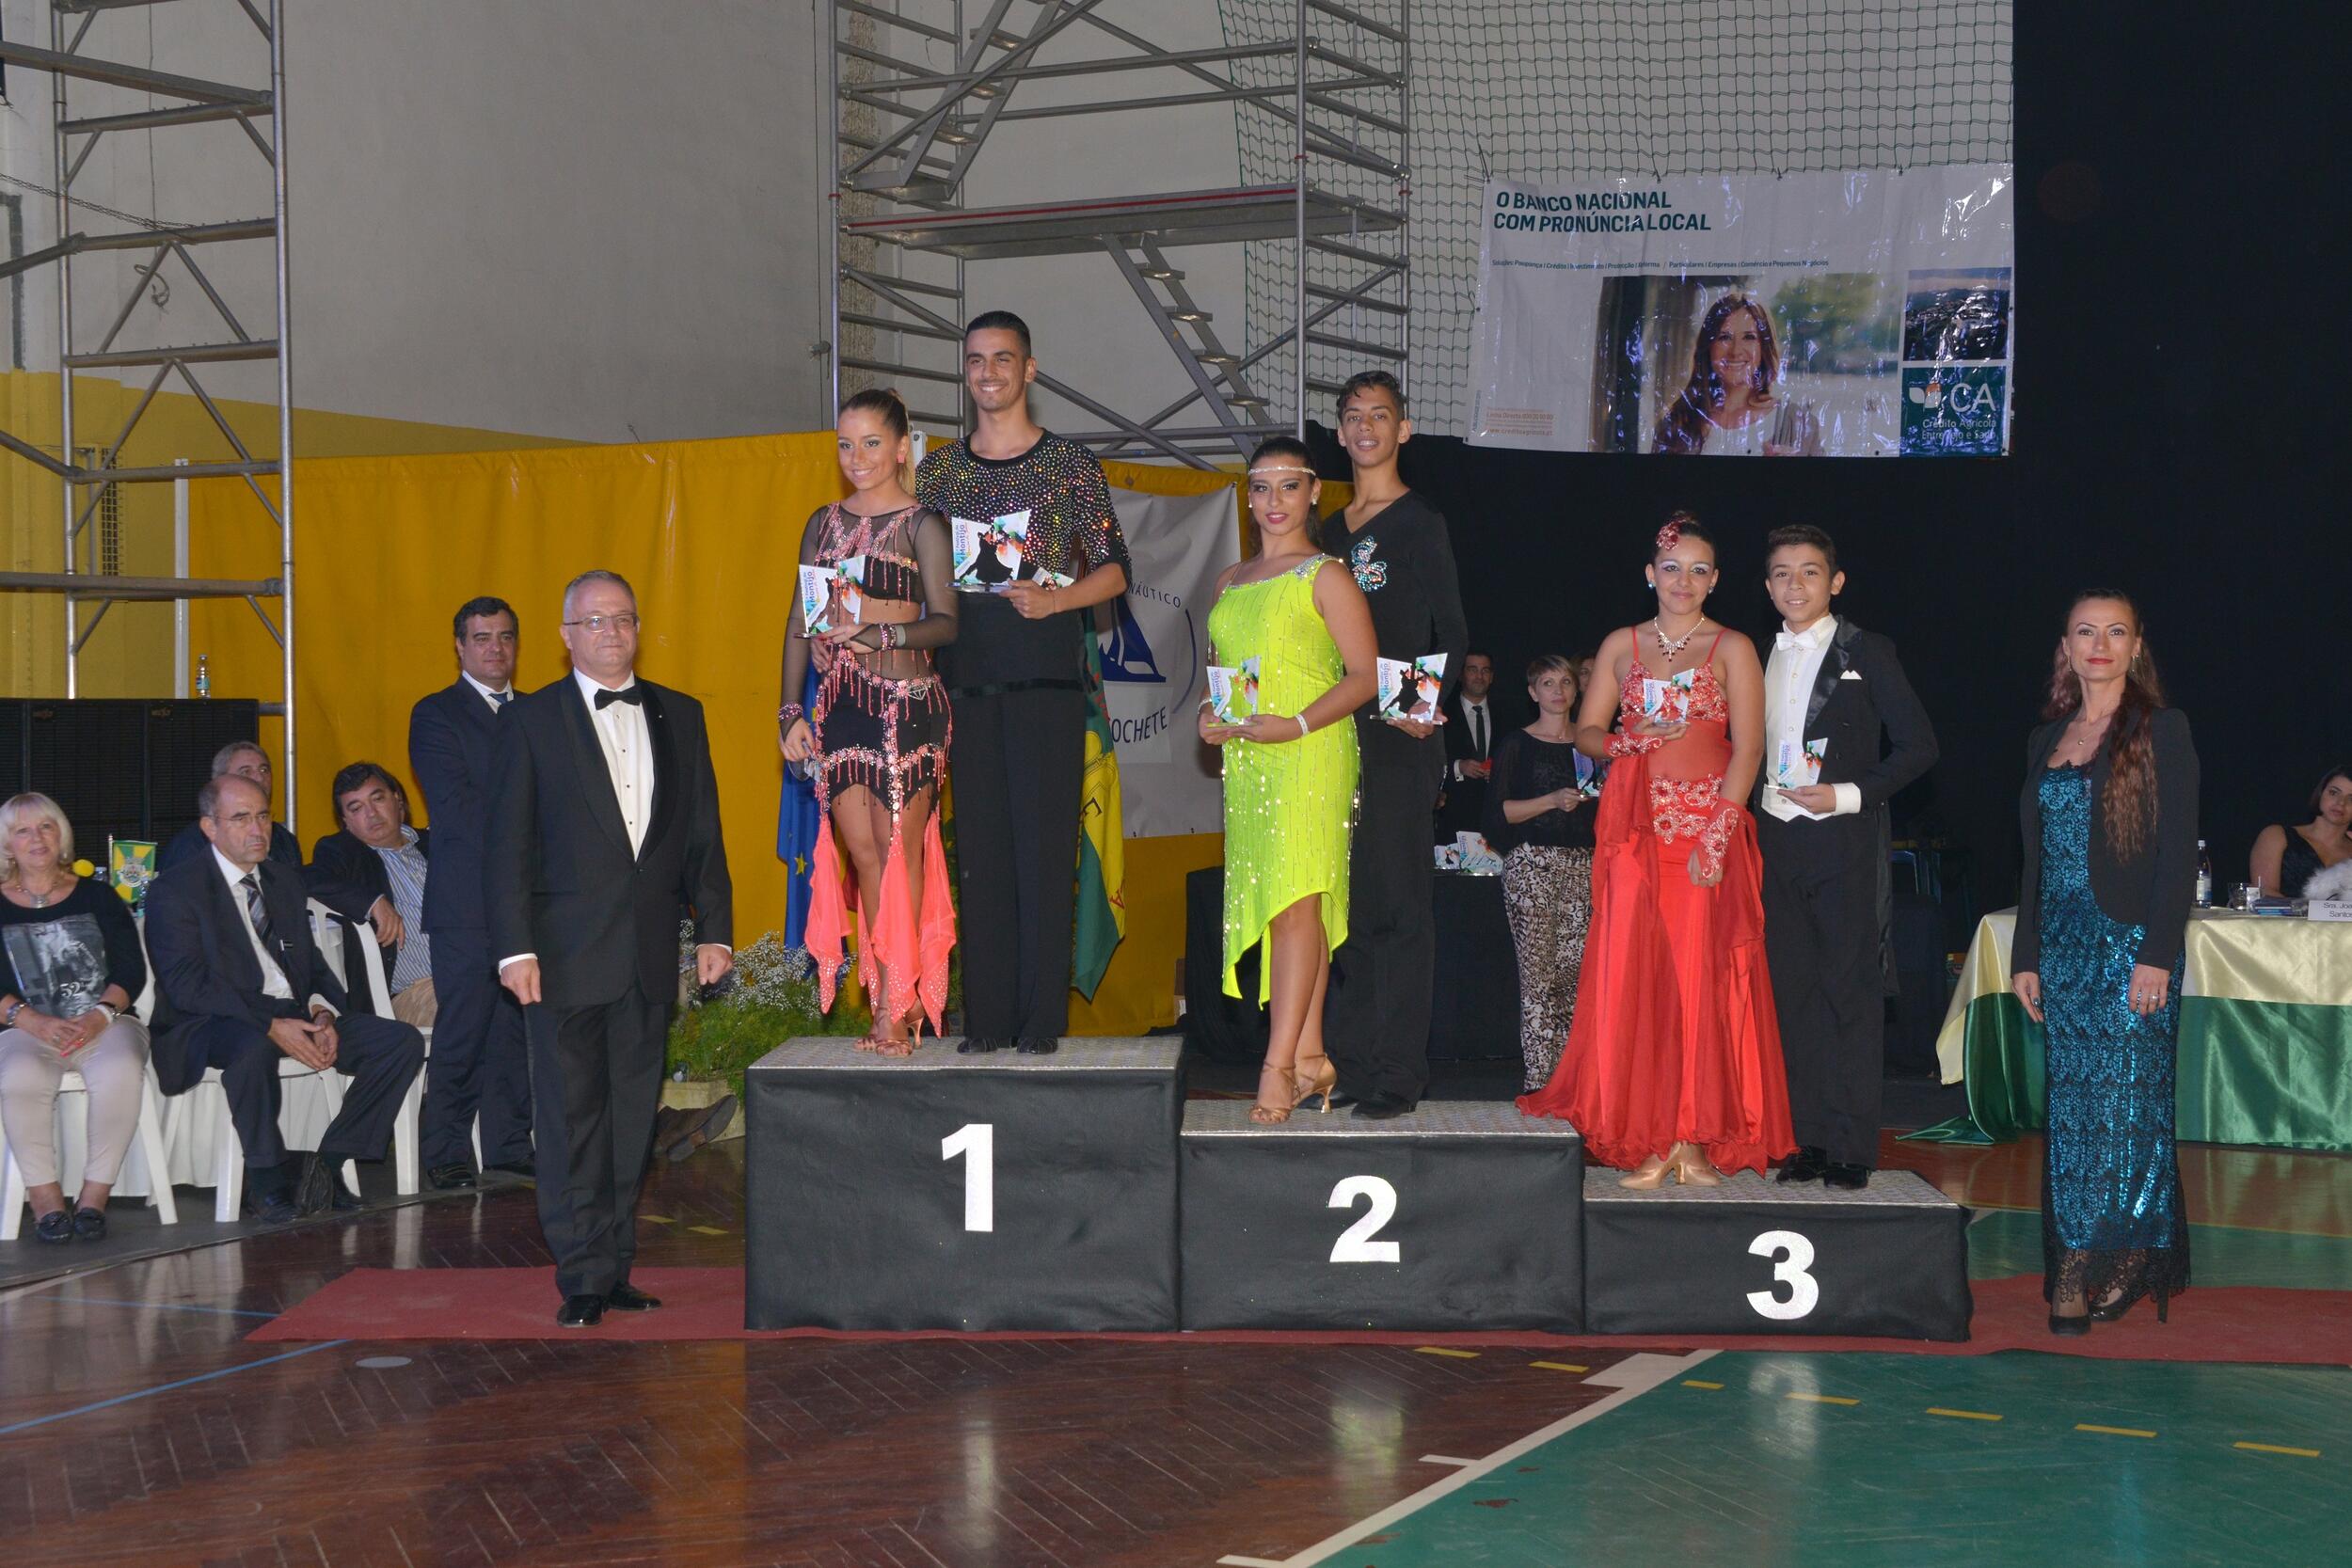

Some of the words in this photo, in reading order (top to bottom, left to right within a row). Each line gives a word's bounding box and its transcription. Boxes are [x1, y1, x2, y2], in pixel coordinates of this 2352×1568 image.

[1496, 191, 1510, 208] O
[1513, 192, 1572, 213] BANCO
[1575, 191, 1672, 211] NACIONAL
[1493, 213, 1535, 231] COM
[1539, 211, 1644, 233] PRONÚNCIA
[1646, 214, 1711, 230] LOCAL
[1802, 259, 1829, 268] Ngócios
[1949, 383, 1996, 412] CA
[807, 571, 816, 603] Montijo
[1129, 581, 1181, 608] NÁUTICO
[941, 1123, 993, 1232] 1
[1327, 1175, 1400, 1263] 2
[1745, 1230, 1820, 1321] 3
